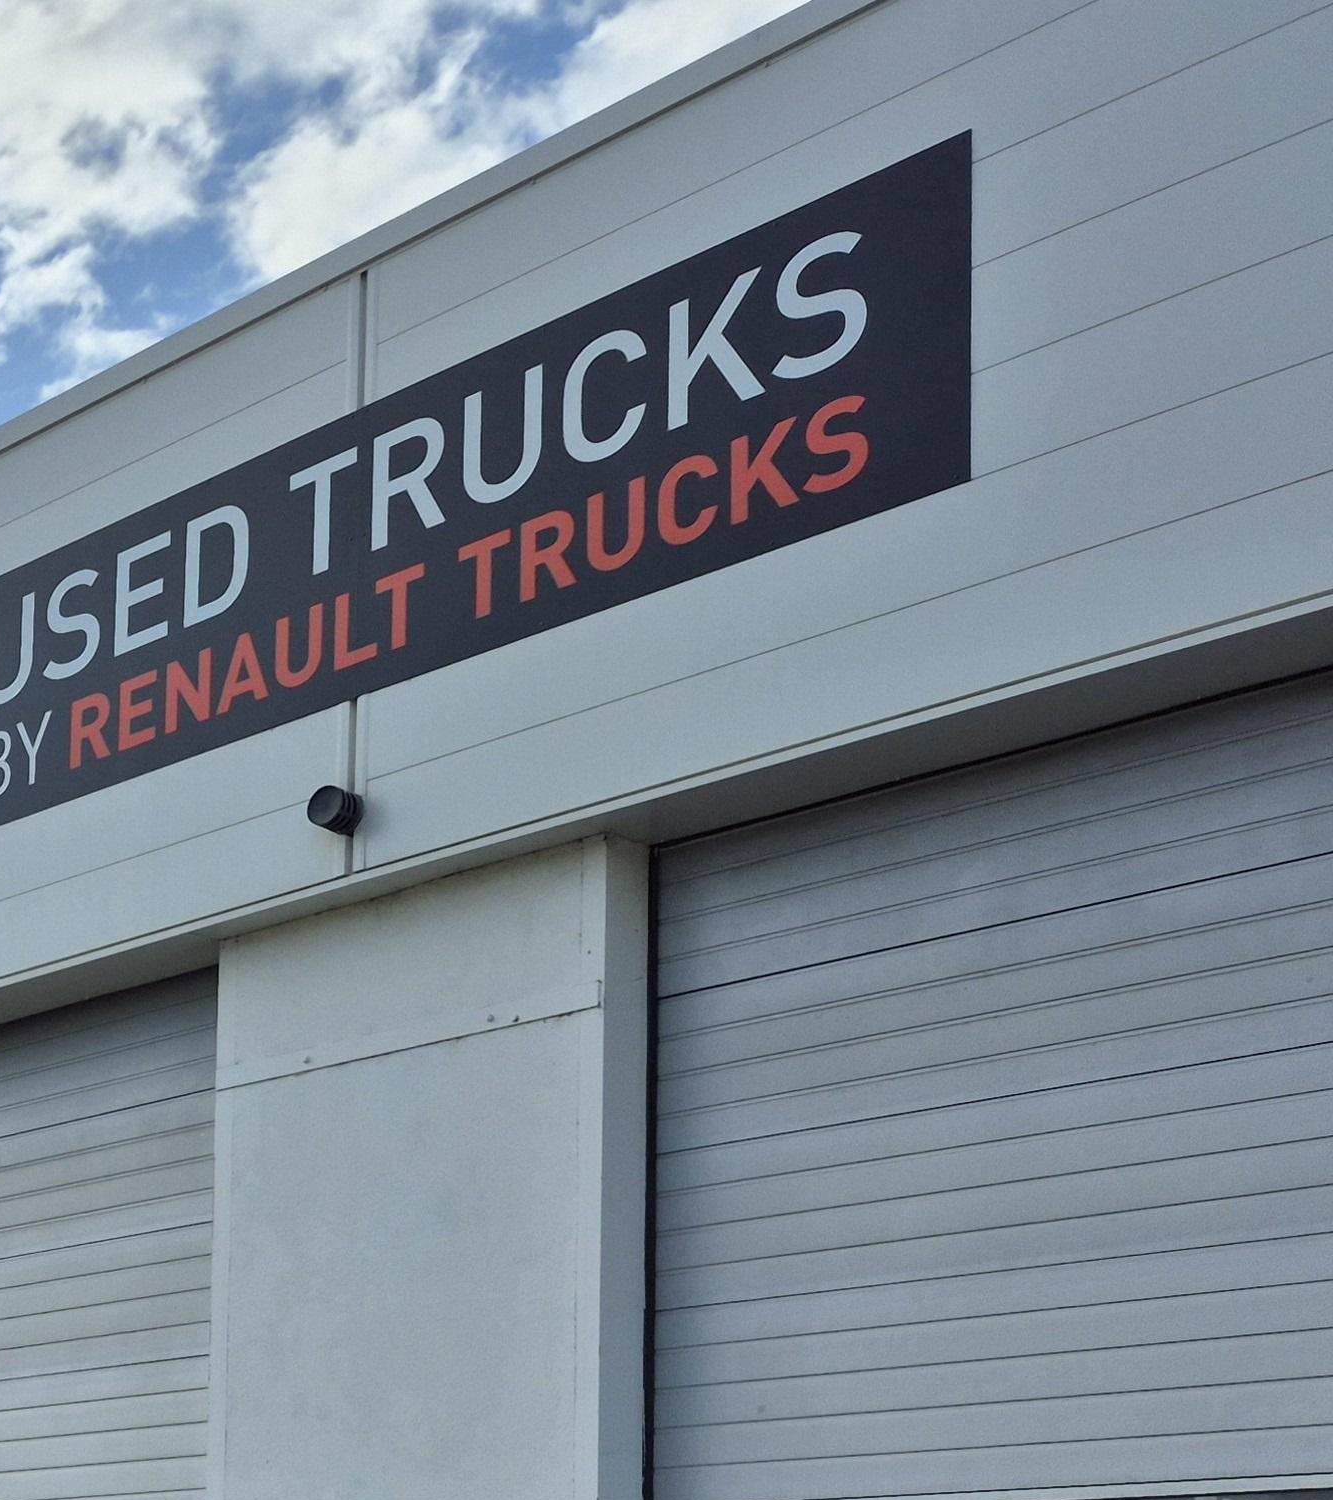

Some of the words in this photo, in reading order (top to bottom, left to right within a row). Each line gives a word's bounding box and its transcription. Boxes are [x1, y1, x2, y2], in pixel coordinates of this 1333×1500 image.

[68, 564, 424, 770] RENAULT
[459, 395, 870, 618] TRUCKS
[289, 231, 868, 576] TRUCKS
